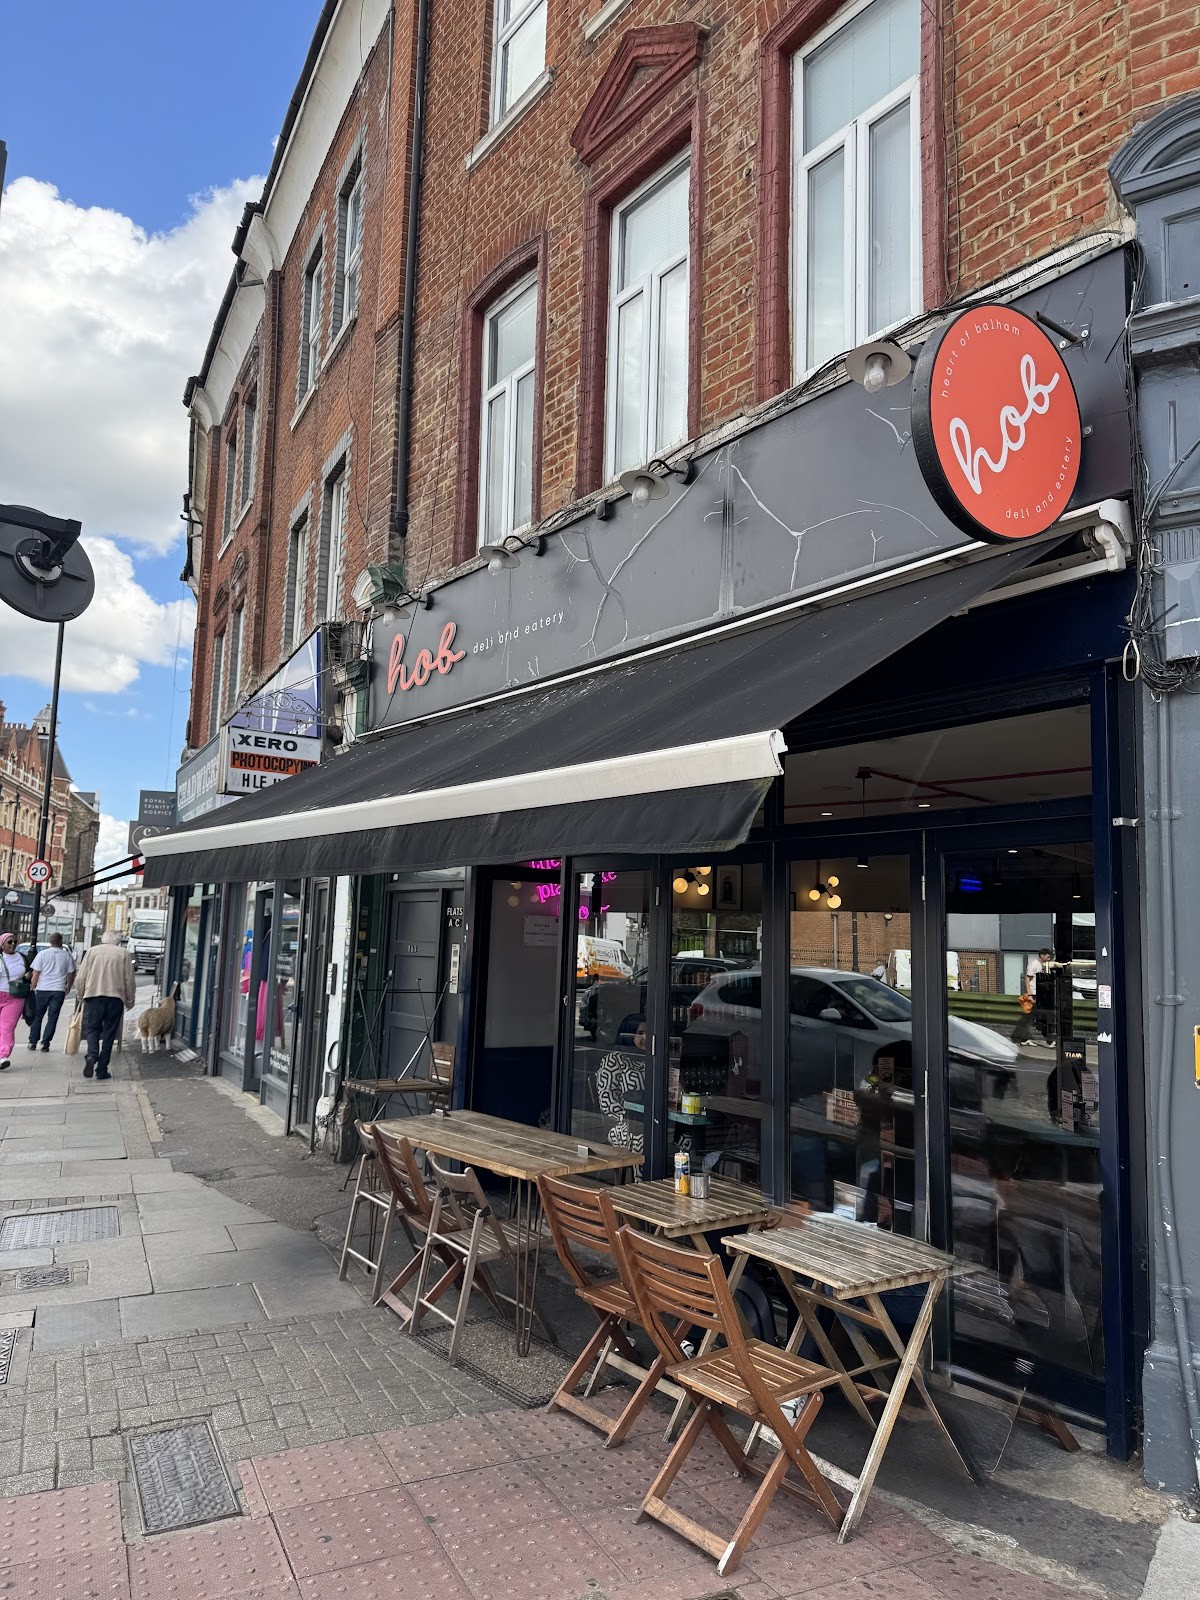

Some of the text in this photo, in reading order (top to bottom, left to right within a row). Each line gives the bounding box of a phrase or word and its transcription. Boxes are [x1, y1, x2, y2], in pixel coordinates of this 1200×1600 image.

[941, 319, 1020, 398] heart of balham
[949, 354, 1060, 495] hob
[1006, 436, 1073, 519] deli and eatery
[387, 621, 466, 695] hob
[473, 610, 564, 654] deli and eatery
[238, 733, 298, 752] XERO
[31, 868, 47, 877] 20
[447, 907, 463, 916] FLATS
